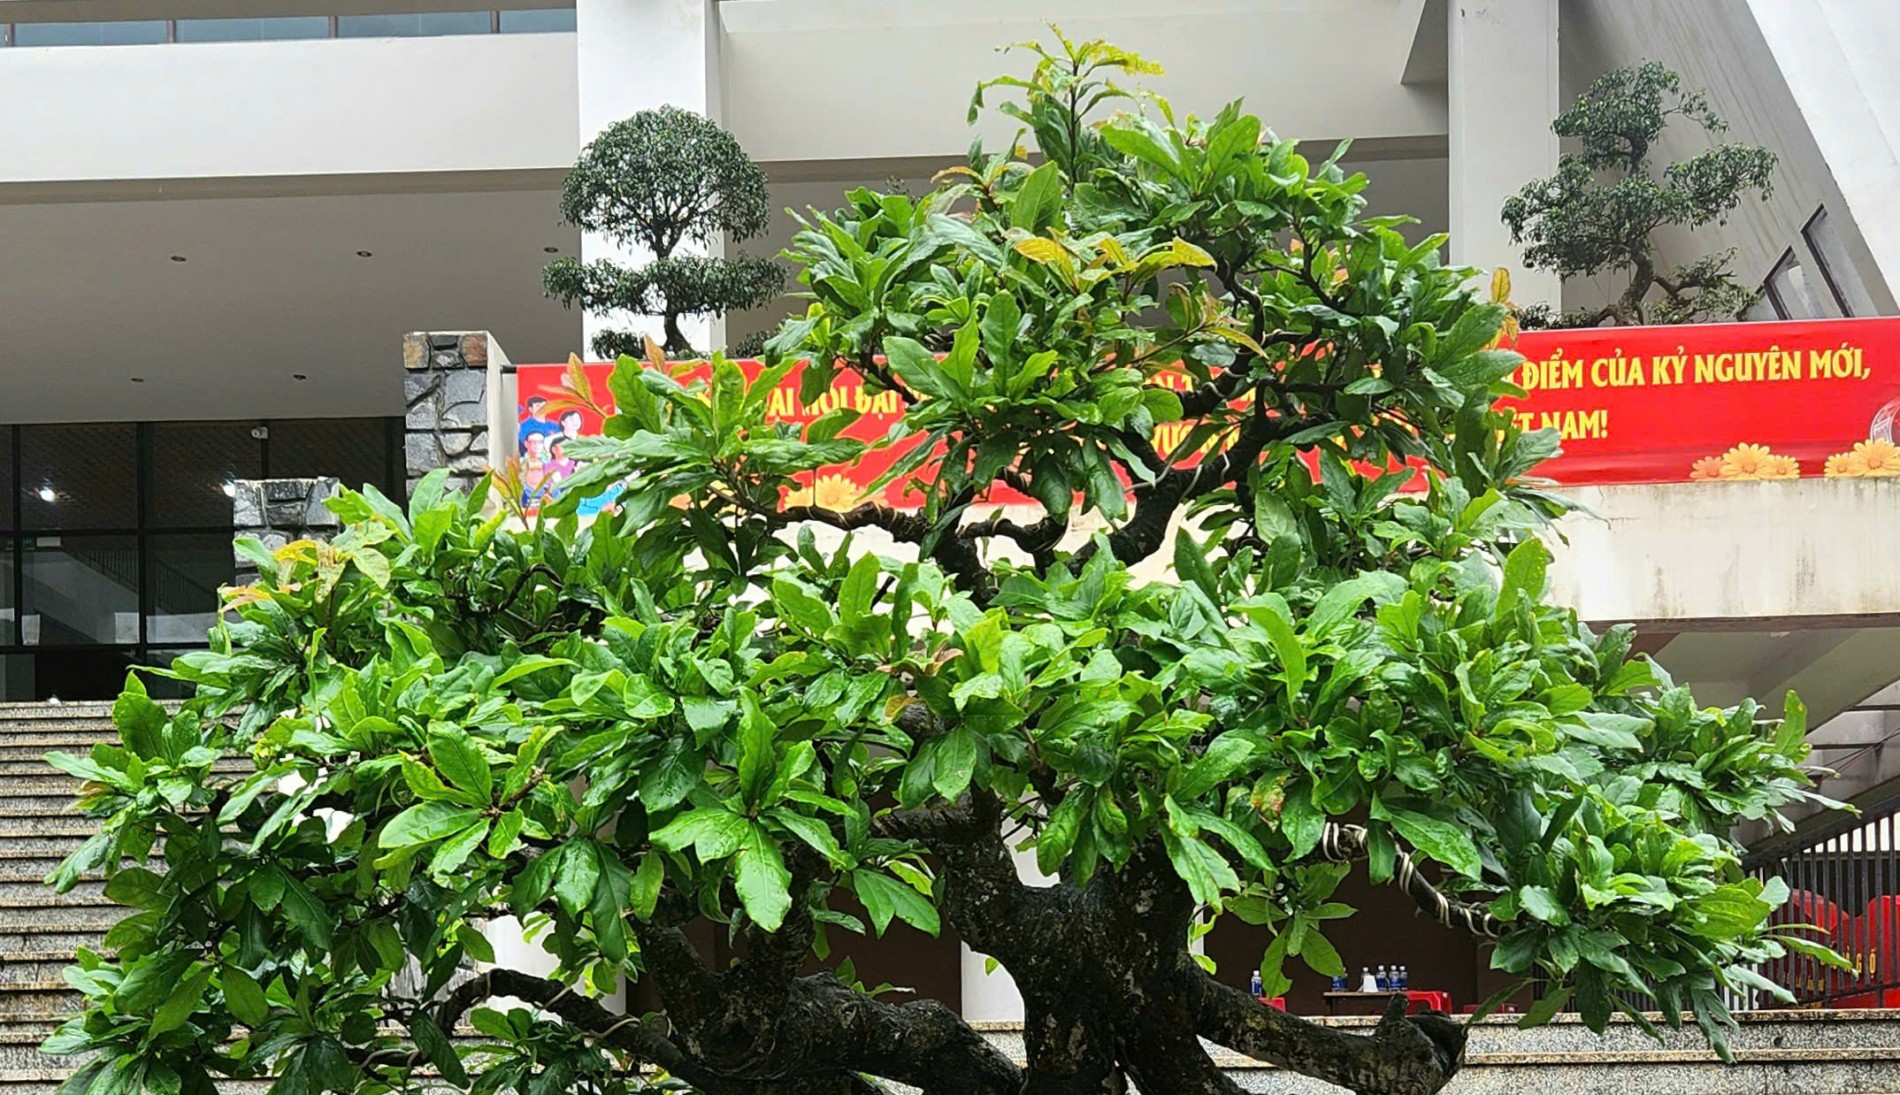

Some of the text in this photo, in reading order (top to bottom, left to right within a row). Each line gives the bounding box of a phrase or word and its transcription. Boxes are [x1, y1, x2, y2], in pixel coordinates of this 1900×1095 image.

[1521, 347, 1584, 390] ĐIỂM
[1591, 348, 1646, 387] CỦA
[1652, 345, 1688, 385] KỶ
[1694, 345, 1802, 383] NGUYÊN
[1809, 342, 1871, 380] MỚI,
[1540, 409, 1608, 440] NAM!
